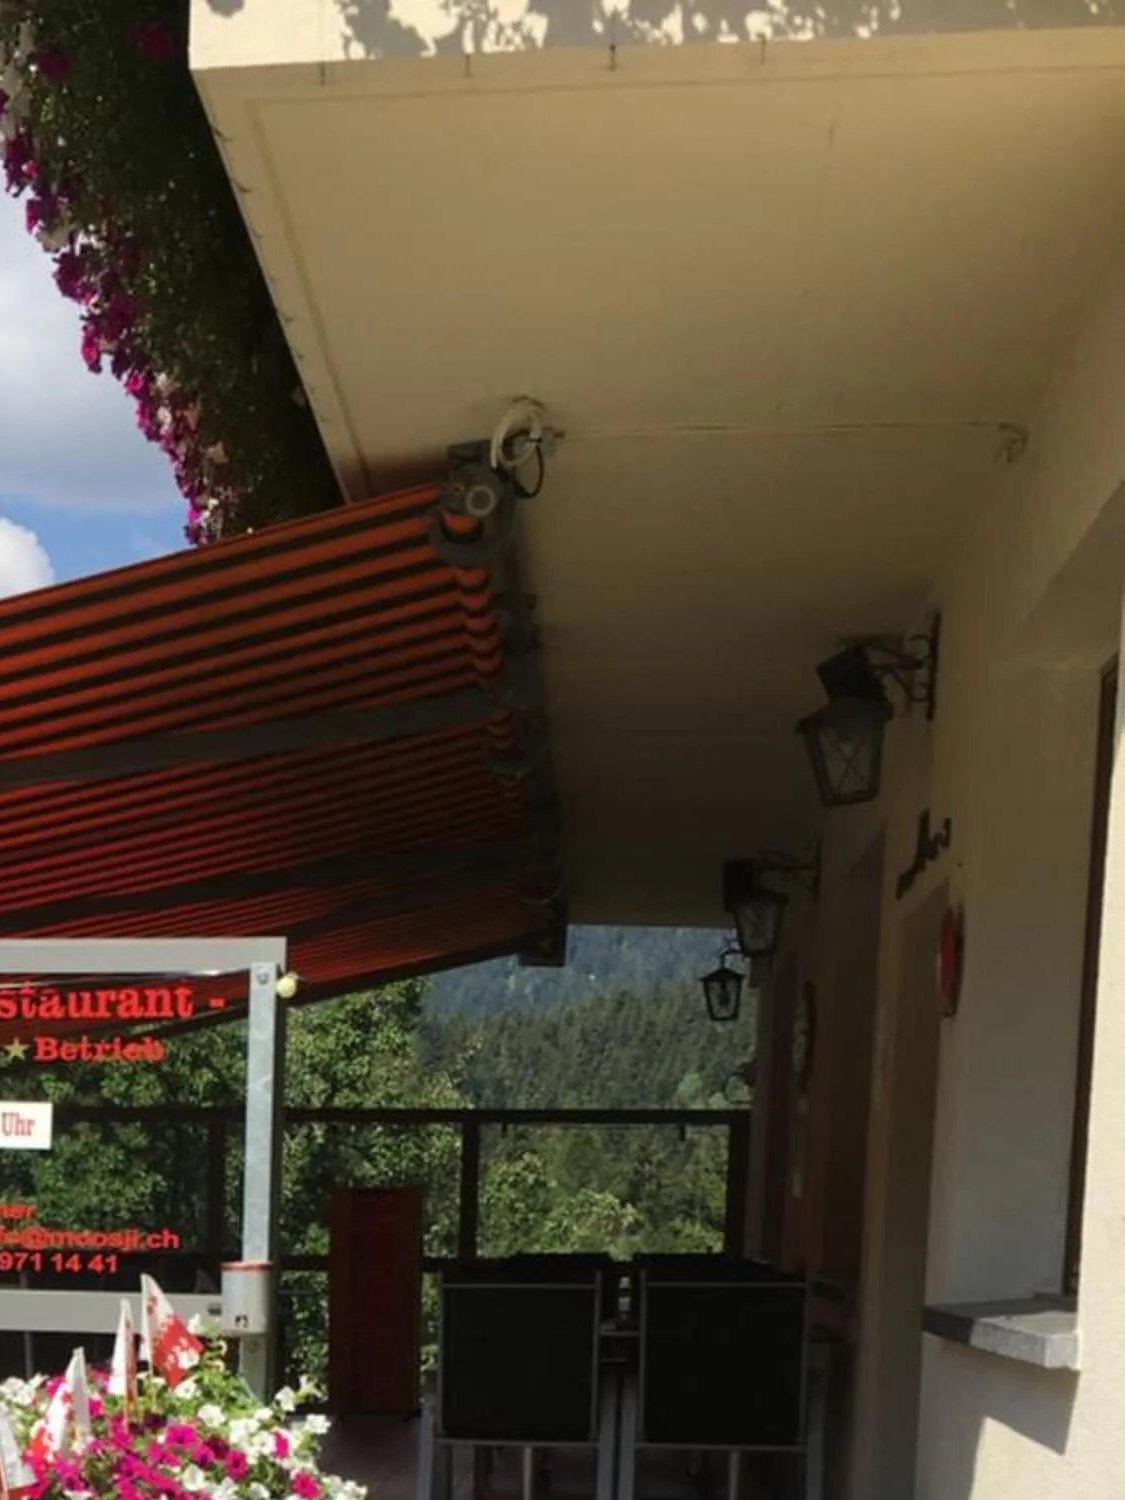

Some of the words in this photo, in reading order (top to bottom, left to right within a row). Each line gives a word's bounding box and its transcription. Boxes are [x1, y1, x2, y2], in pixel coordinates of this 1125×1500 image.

[2, 1111, 36, 1137] Uhr
[51, 1253, 81, 1272] 14
[87, 1254, 118, 1273] 41
